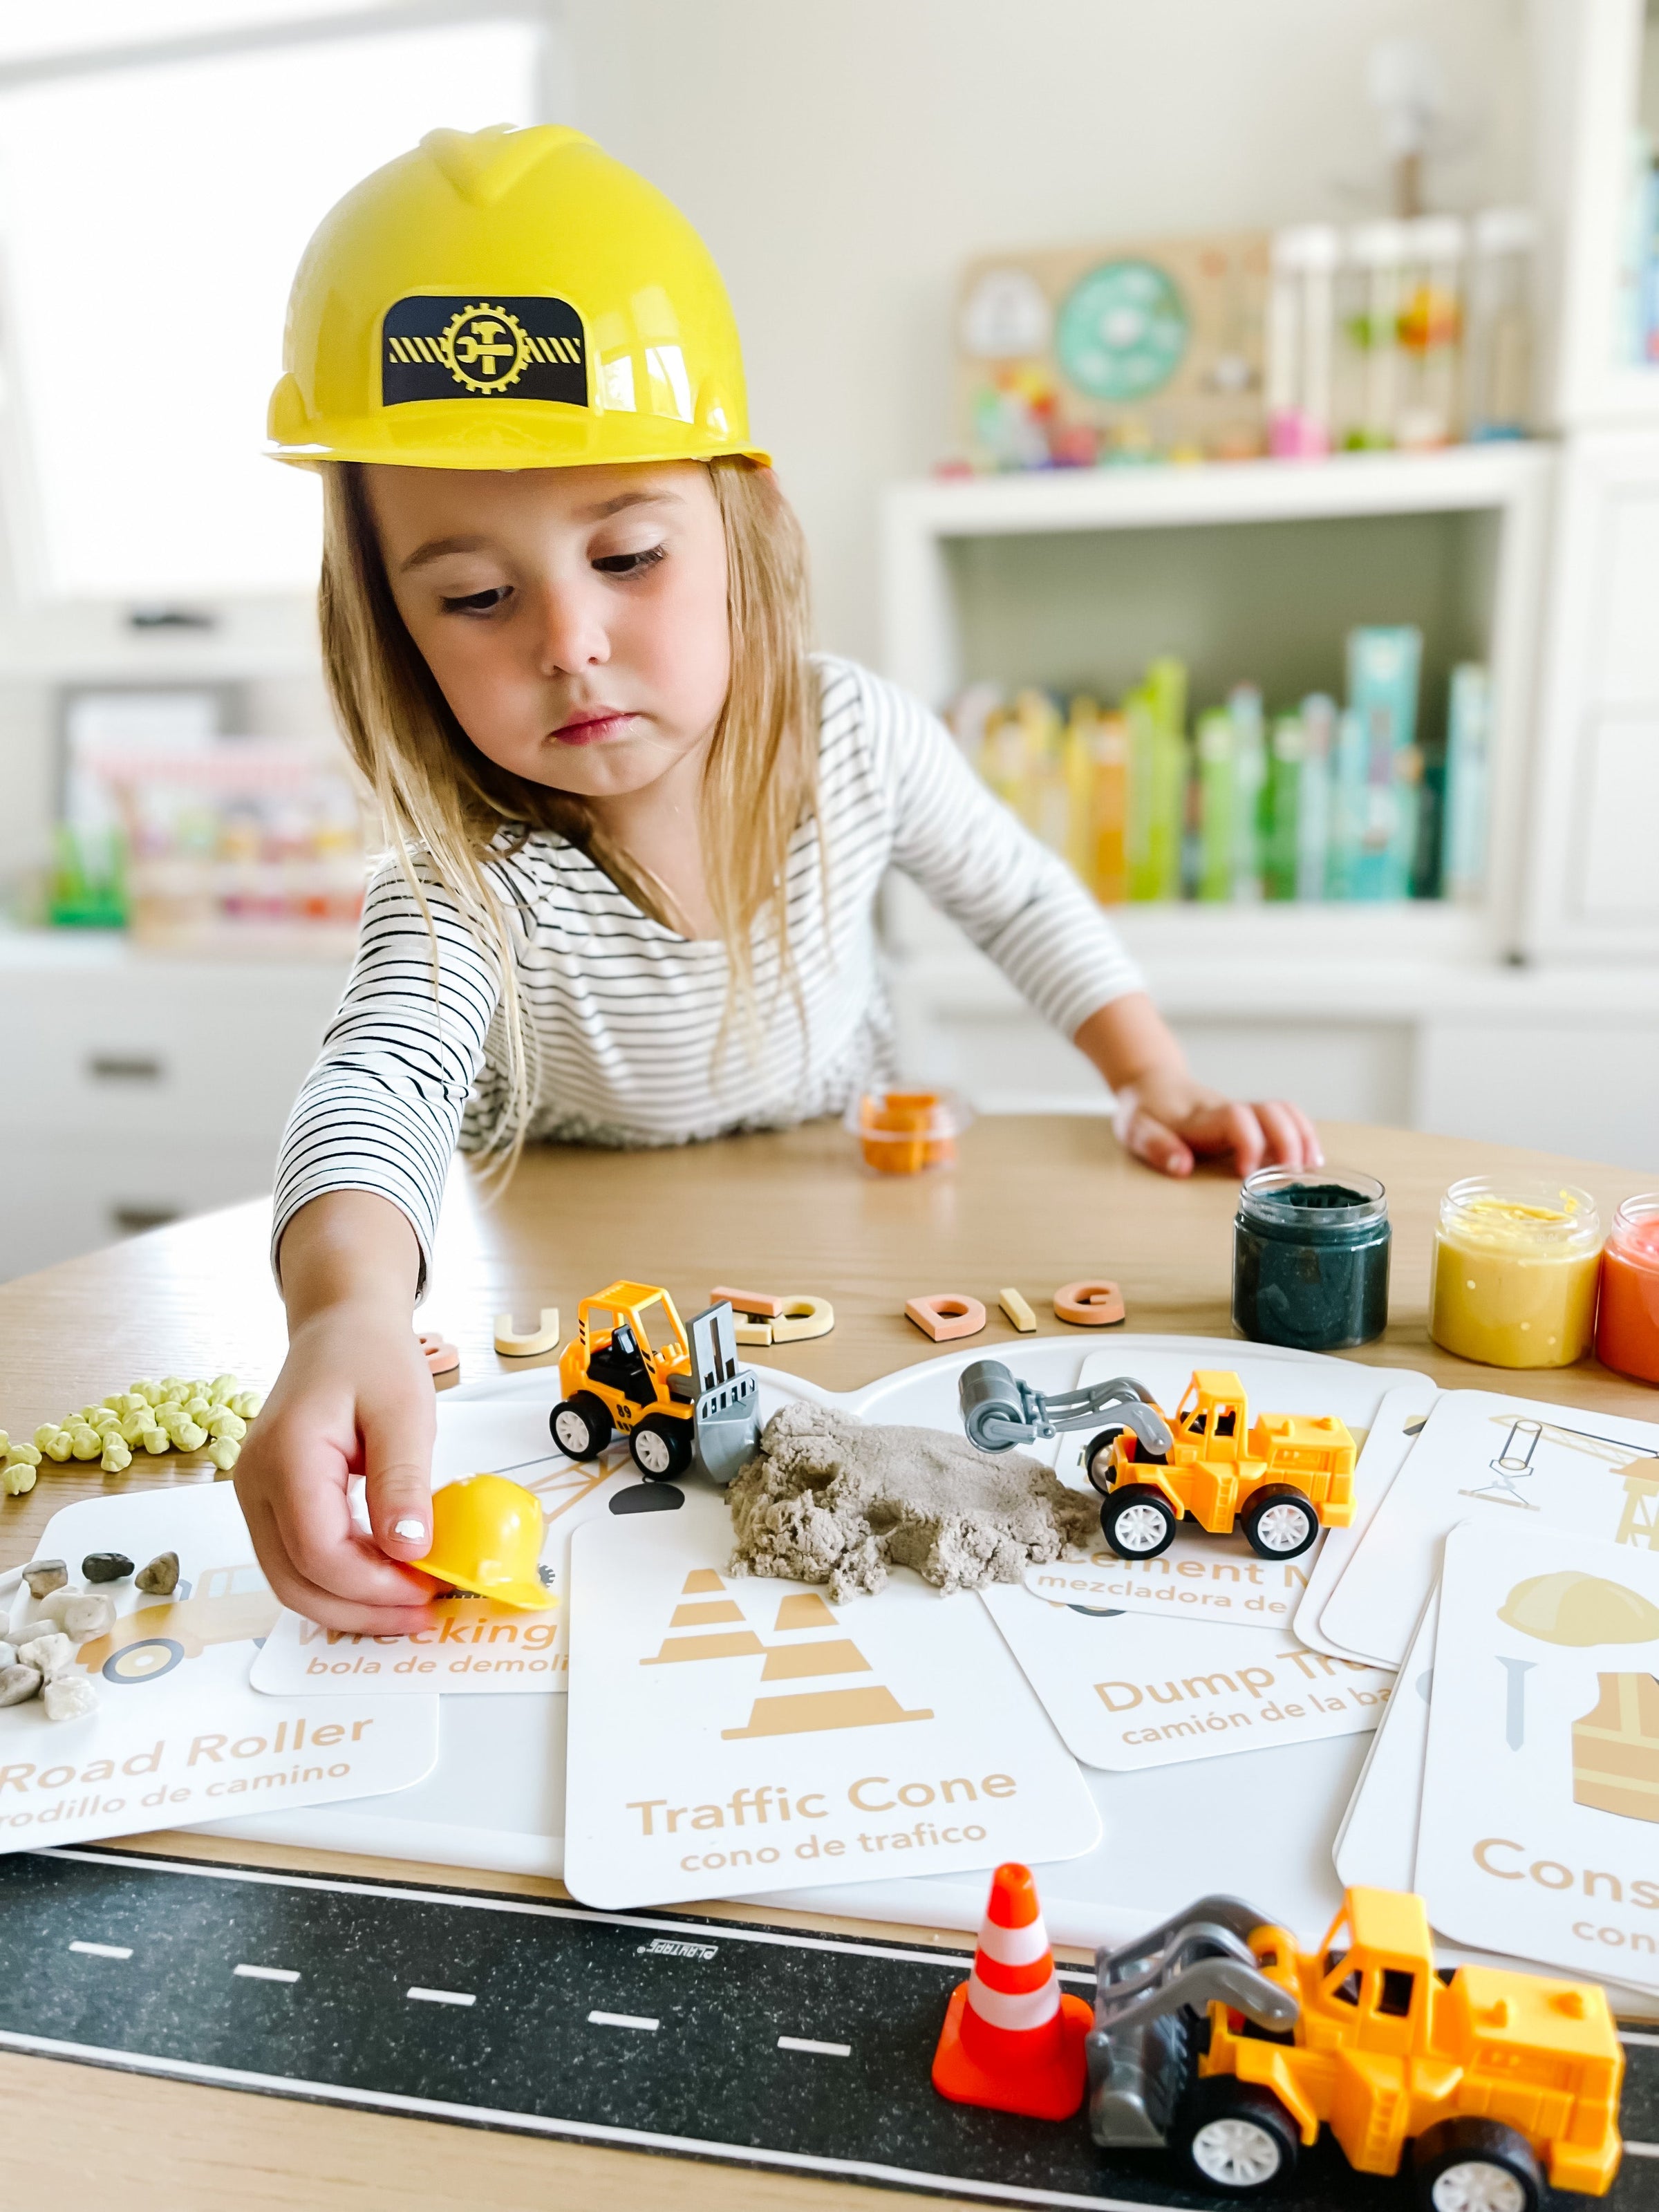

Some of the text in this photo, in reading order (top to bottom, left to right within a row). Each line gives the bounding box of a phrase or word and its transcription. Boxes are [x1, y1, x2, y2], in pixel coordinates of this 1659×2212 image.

[904, 1280, 1125, 1343] DIG
[616, 1404, 632, 1418] 89
[1056, 1551, 1264, 1585] ement
[1038, 1575, 1288, 1613] mezcladora de
[306, 1657, 382, 1675] bola
[393, 1656, 437, 1674] de
[1093, 1649, 1372, 1712] Dump Tr
[1121, 1711, 1253, 1745] camión
[1259, 1700, 1306, 1722] de
[1307, 1694, 1347, 1714] la
[0, 1718, 373, 1794] Road Roller
[140, 1784, 192, 1808] de
[206, 1763, 351, 1798] camino
[626, 1773, 1018, 1836] Traffic Cone
[679, 1822, 987, 1873] cono de trafico
[1472, 1837, 1659, 1910] Cons
[1572, 1921, 1656, 1954] con
